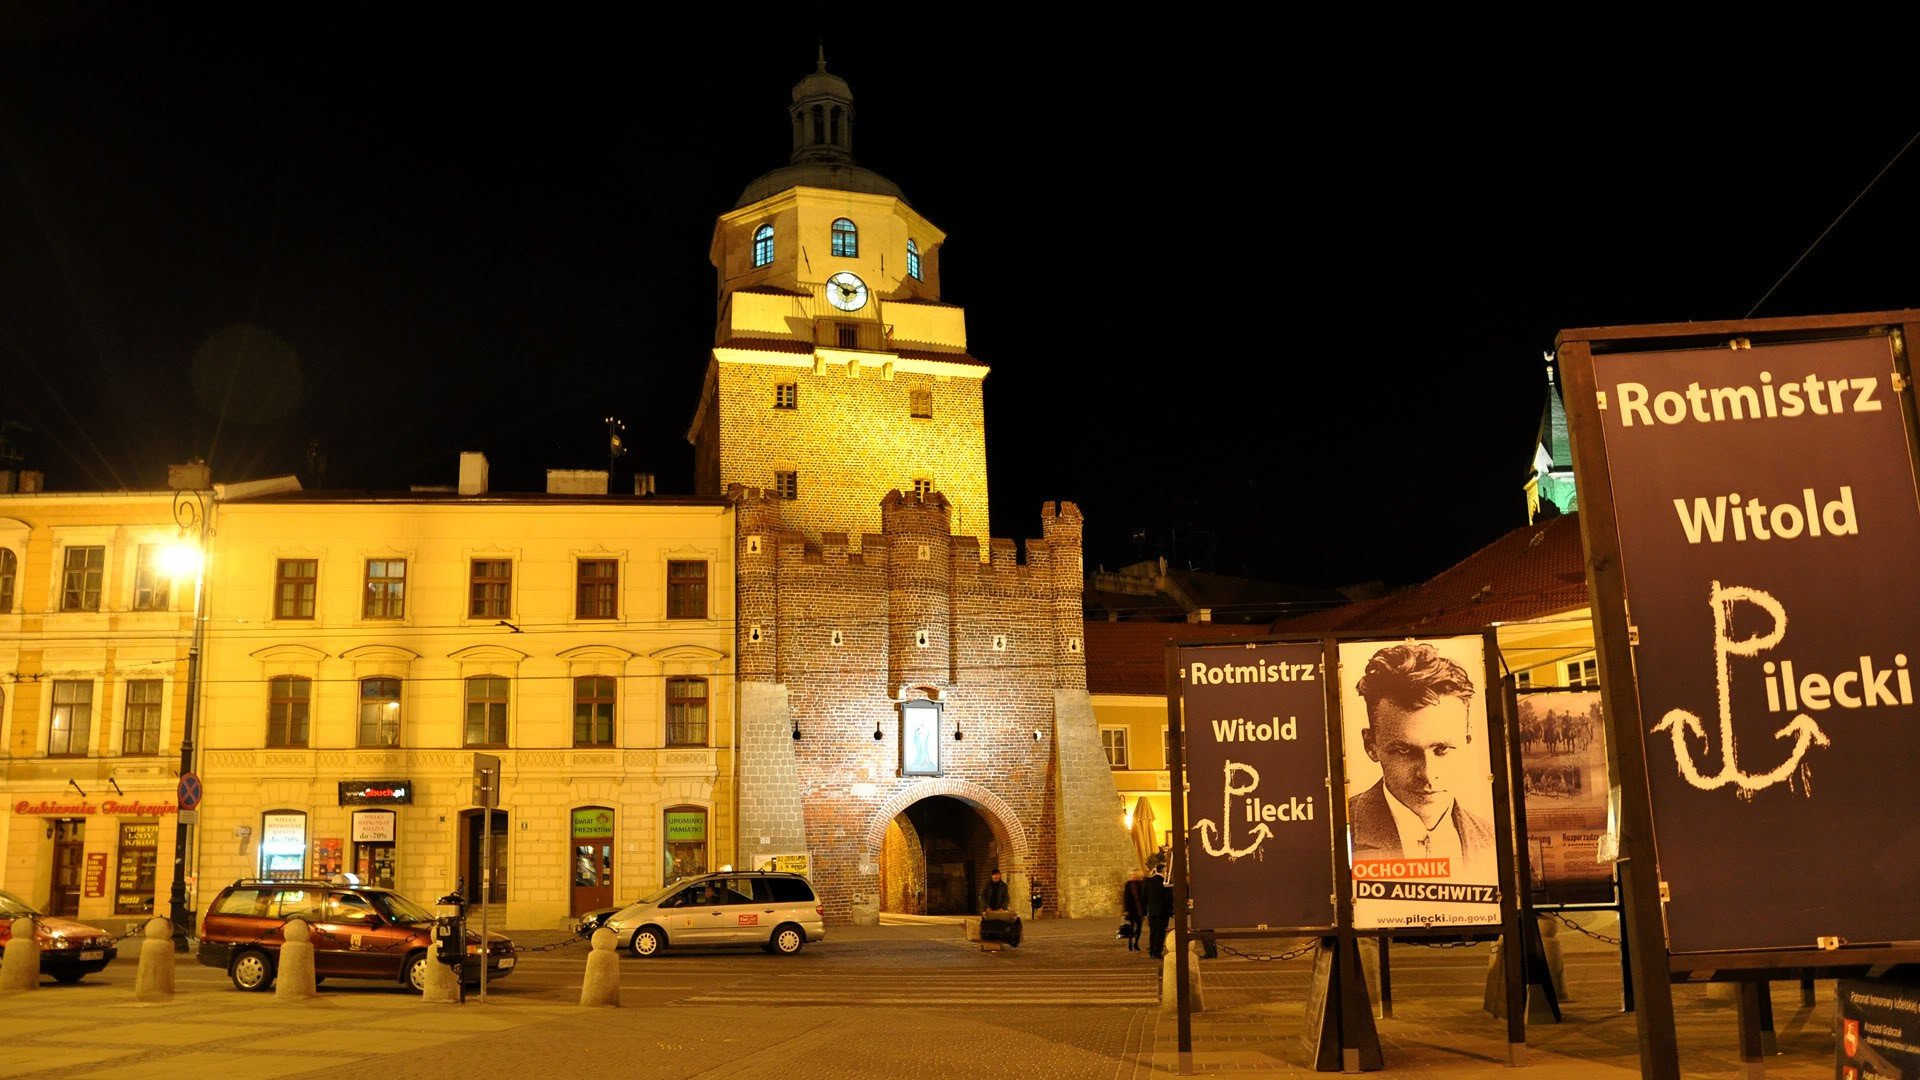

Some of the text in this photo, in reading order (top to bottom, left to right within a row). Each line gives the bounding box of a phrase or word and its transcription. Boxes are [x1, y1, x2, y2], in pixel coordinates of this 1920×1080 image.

[1616, 371, 1882, 427] Rotmistrz
[1673, 486, 1858, 544] Witold
[1191, 659, 1315, 685] Rotmistrz
[1212, 716, 1298, 743] Witold
[102, 800, 178, 817] Tradycyjn
[1353, 861, 1449, 878] OCHOTNIK
[1359, 883, 1493, 902] DO AUSCHWITZ
[1377, 913, 1496, 925] www.pilecki.ipn.gov.pl
